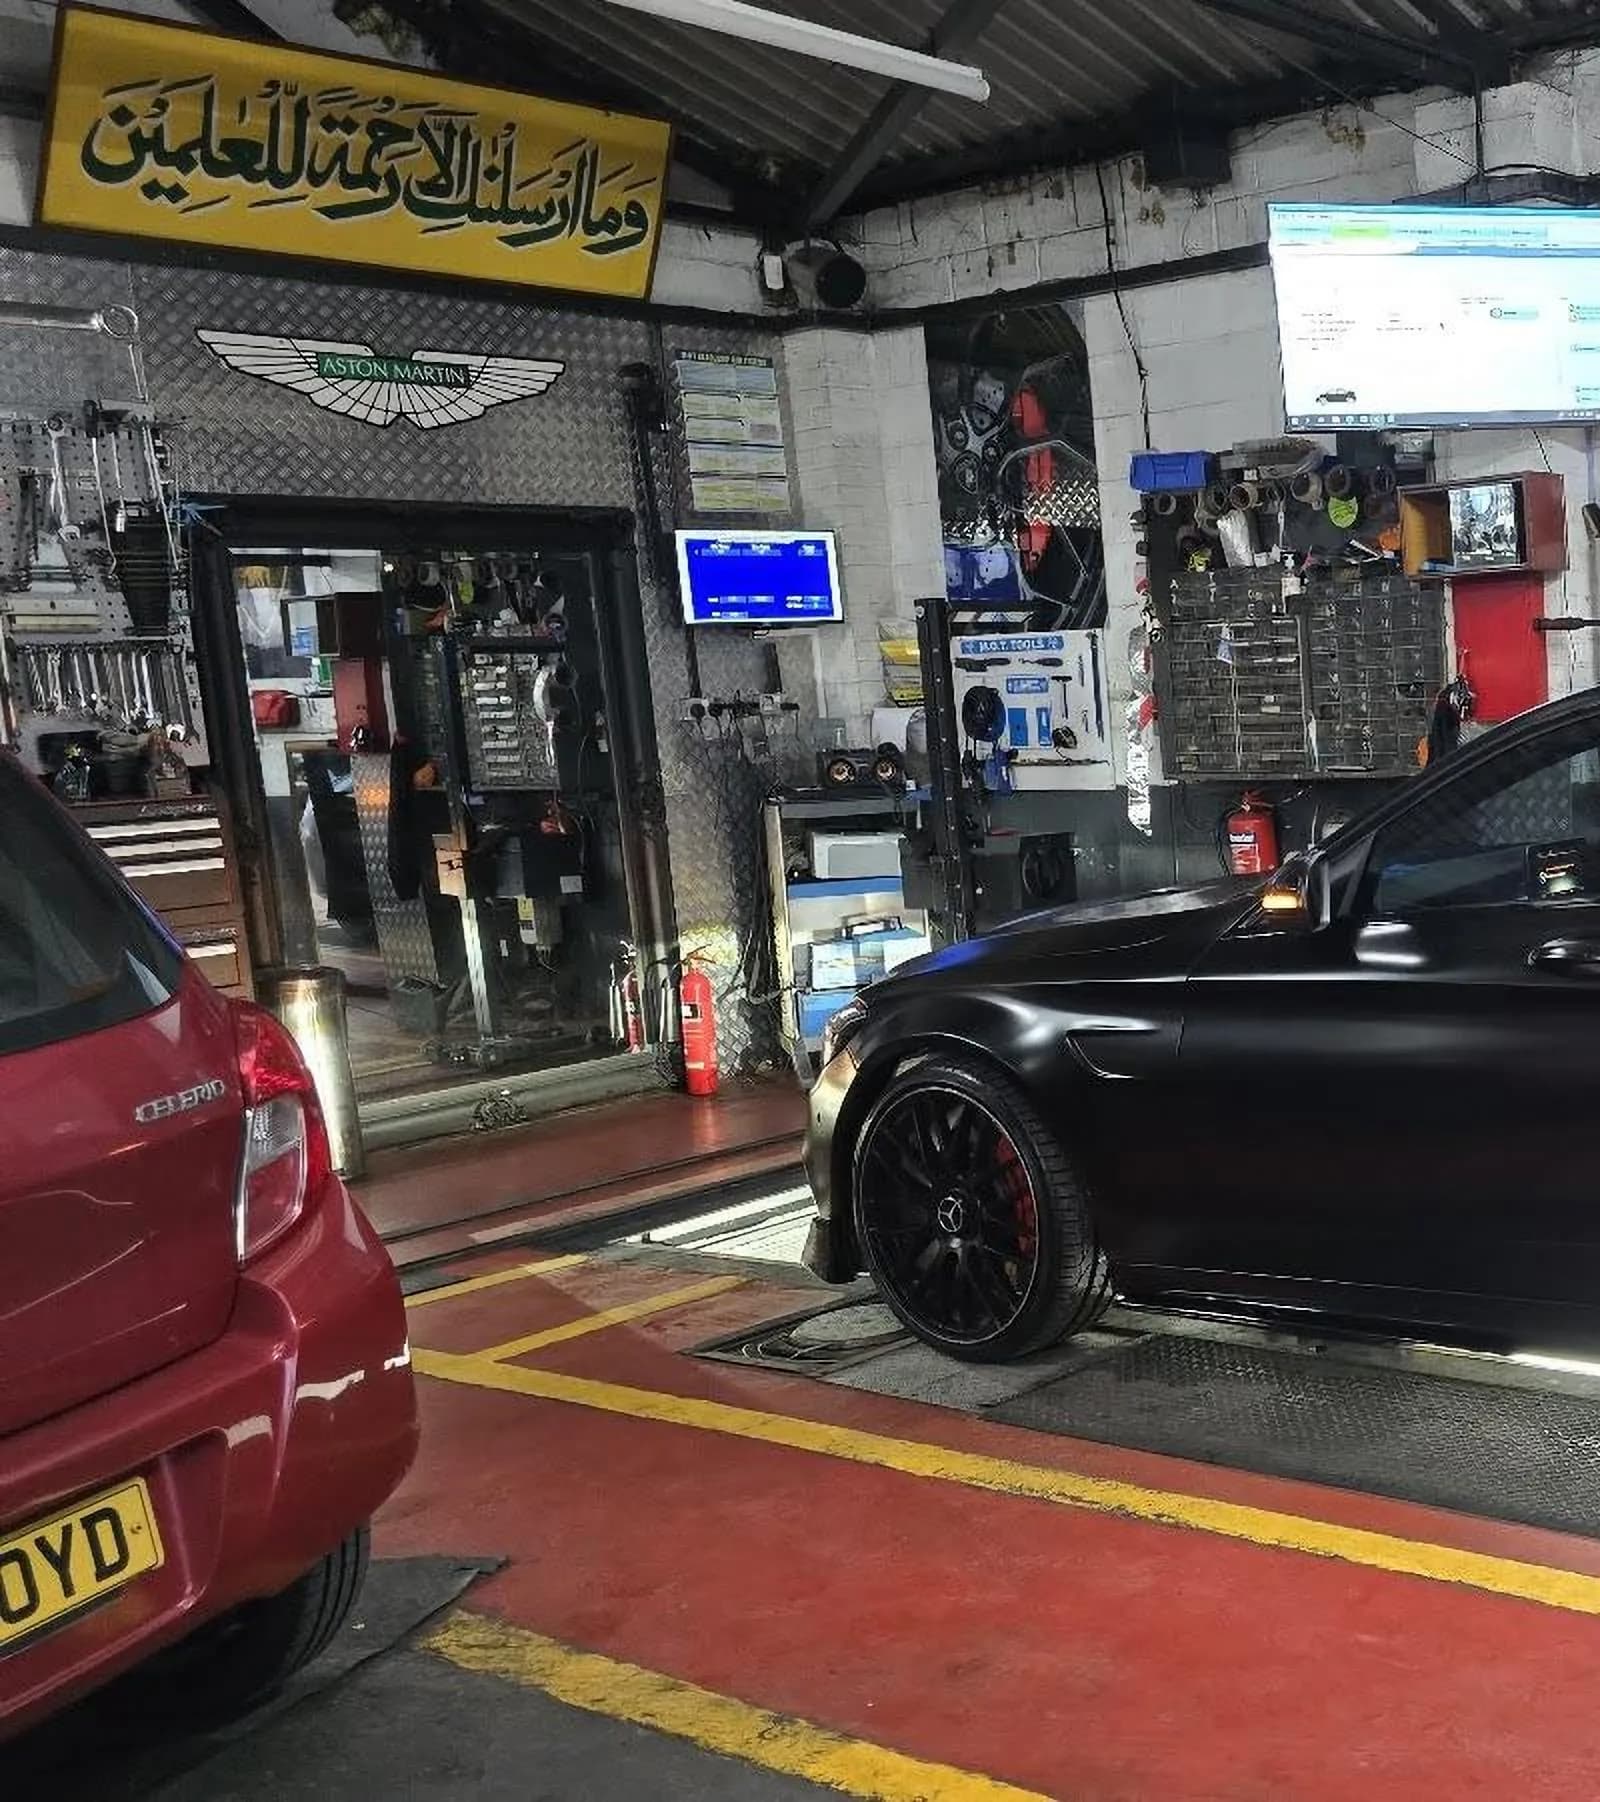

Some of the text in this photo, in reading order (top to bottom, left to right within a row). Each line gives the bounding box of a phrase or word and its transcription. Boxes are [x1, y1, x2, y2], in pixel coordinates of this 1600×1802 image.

[323, 356, 466, 385] ASTON MARTIN
[1010, 638, 1045, 651] TOOLS
[135, 1079, 226, 1123] CELERIO
